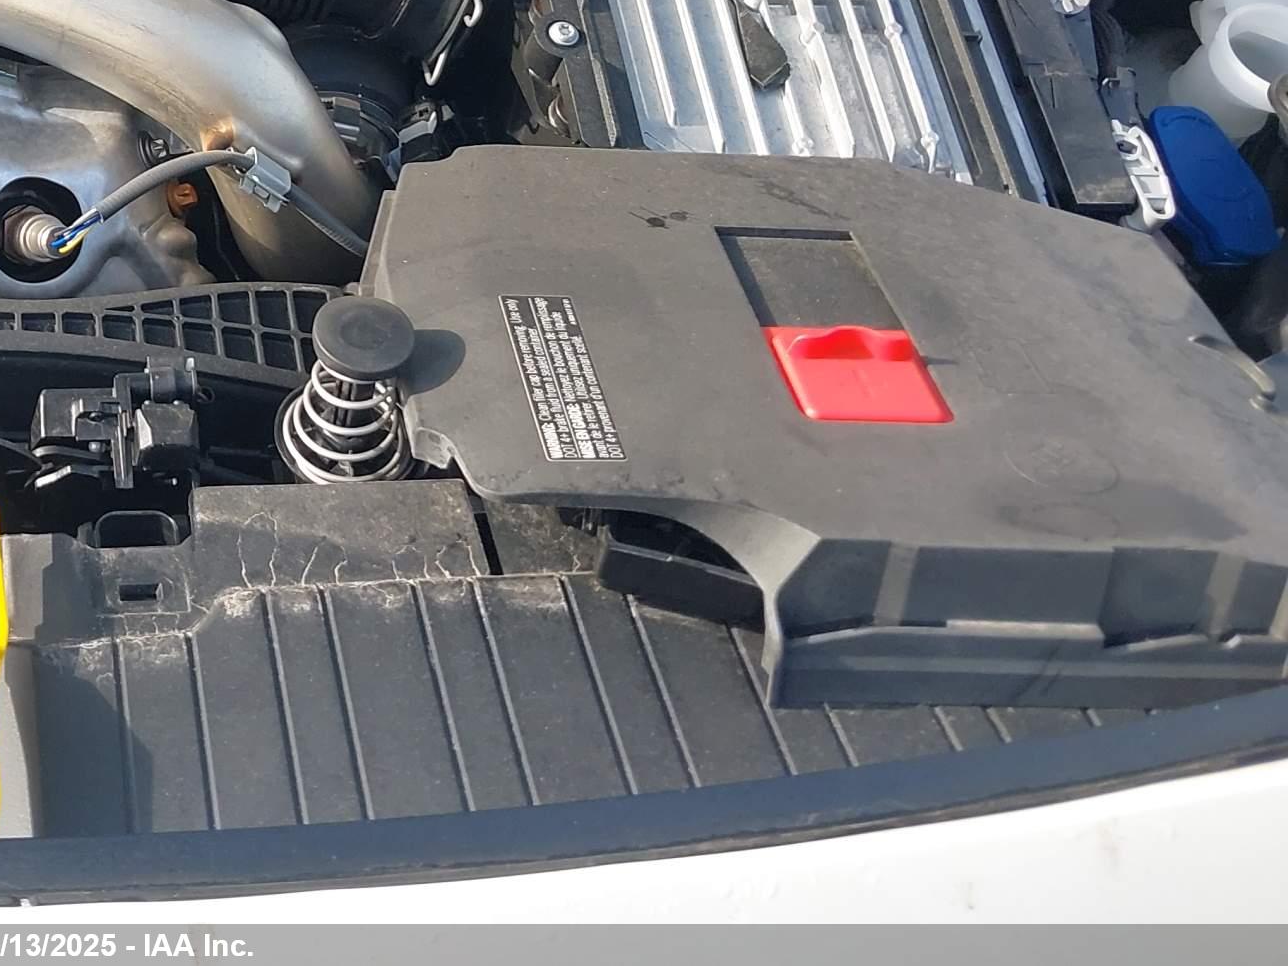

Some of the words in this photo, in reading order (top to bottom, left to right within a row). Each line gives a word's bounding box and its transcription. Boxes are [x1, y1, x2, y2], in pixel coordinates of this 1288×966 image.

[505, 299, 518, 311] only
[510, 312, 522, 323] Use
[534, 298, 556, 331] remplissage
[551, 312, 566, 330] liquide
[548, 341, 565, 366] bouchon
[559, 340, 583, 375] uniquement
[523, 354, 537, 373] before
[534, 356, 551, 376] sealed
[577, 355, 597, 384] contenant
[529, 375, 541, 386] cap
[559, 374, 576, 401] Nettoyez
[573, 377, 589, 399] Utilisez
[532, 387, 545, 401] filler
[545, 383, 557, 397] from
[538, 403, 551, 420] Clean
[547, 399, 562, 412] fluid
[553, 414, 569, 432] brake
[567, 403, 586, 428] GARDE:
[592, 401, 616, 432] provenant
[560, 433, 571, 441] 4+
[575, 430, 590, 439] EN
[590, 430, 602, 438] de
[605, 434, 616, 442] 4+
[561, 444, 577, 458] DOT
[578, 441, 596, 458] MISE
[592, 440, 609, 458] avant
[606, 443, 624, 458] DOT
